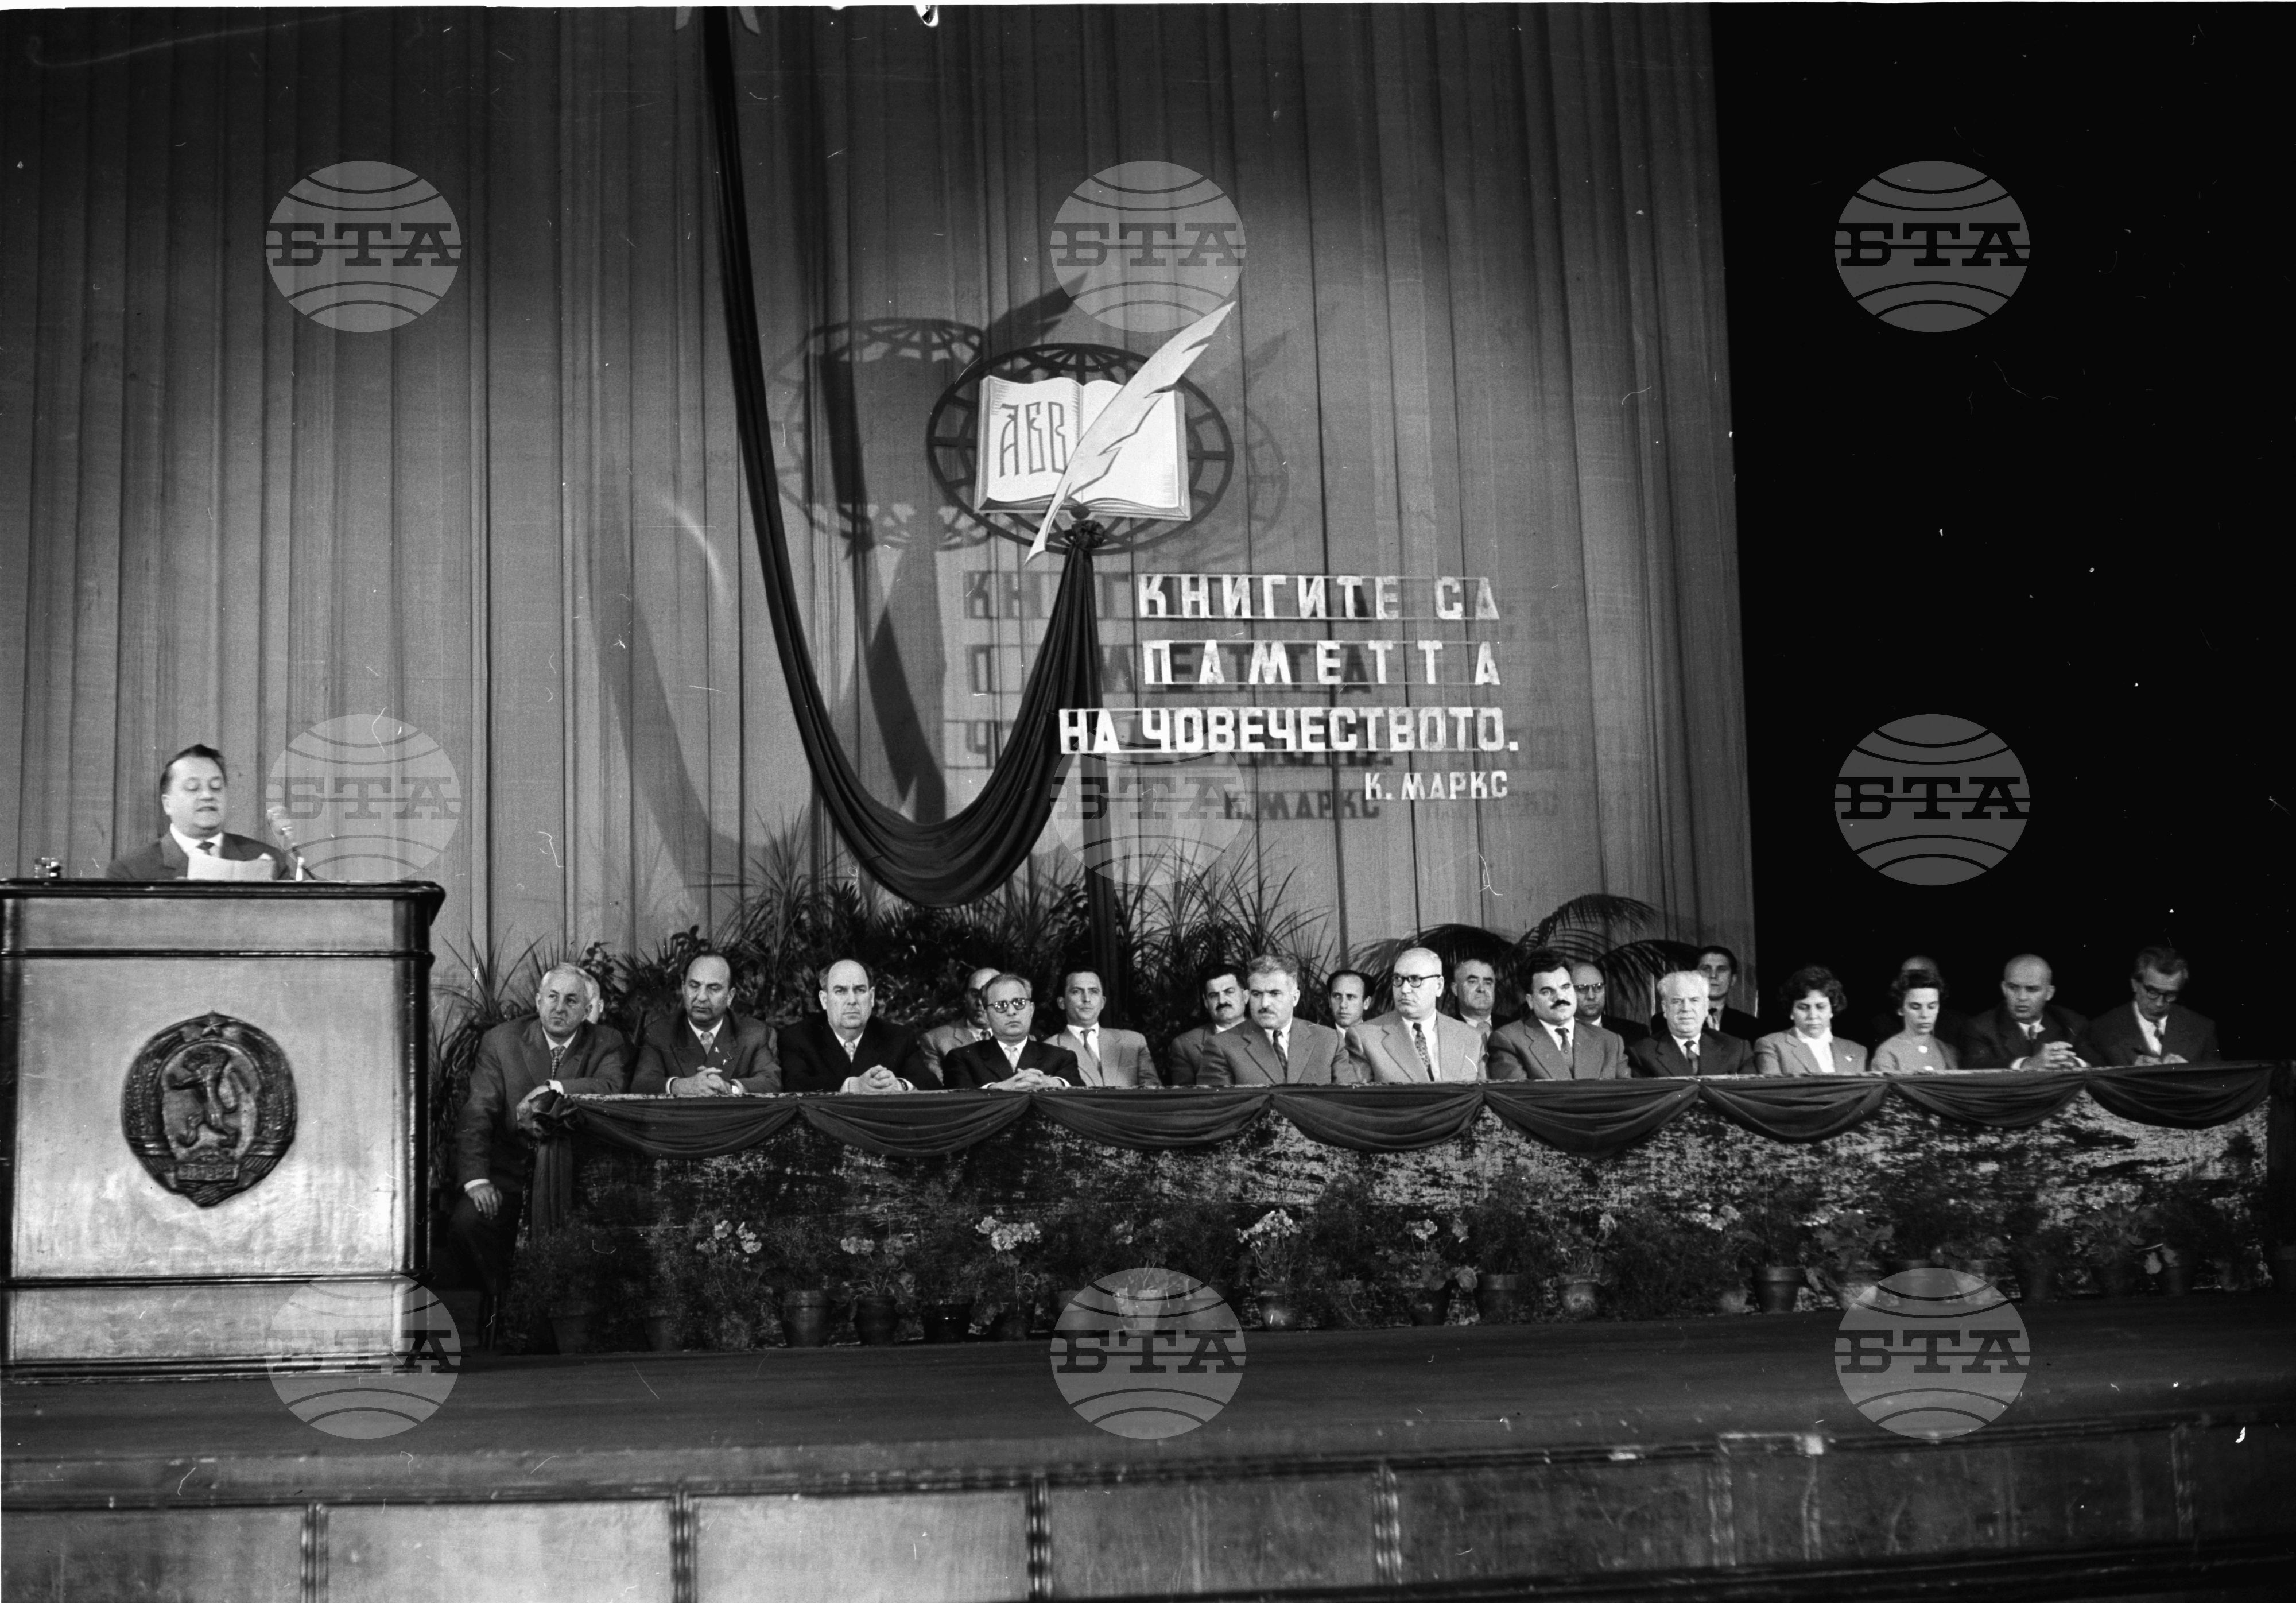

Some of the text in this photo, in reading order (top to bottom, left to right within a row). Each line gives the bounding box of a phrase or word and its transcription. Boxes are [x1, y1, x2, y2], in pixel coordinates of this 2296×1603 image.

[1138, 574, 1399, 620] КНИГИТЕ
[1436, 576, 1500, 620] СА
[1142, 640, 1500, 685] ПАМЕТТА
[1059, 707, 1519, 753] НА ЧОВЕЧЕСТВОТО.
[1364, 770, 1508, 800] К. МАРКС
